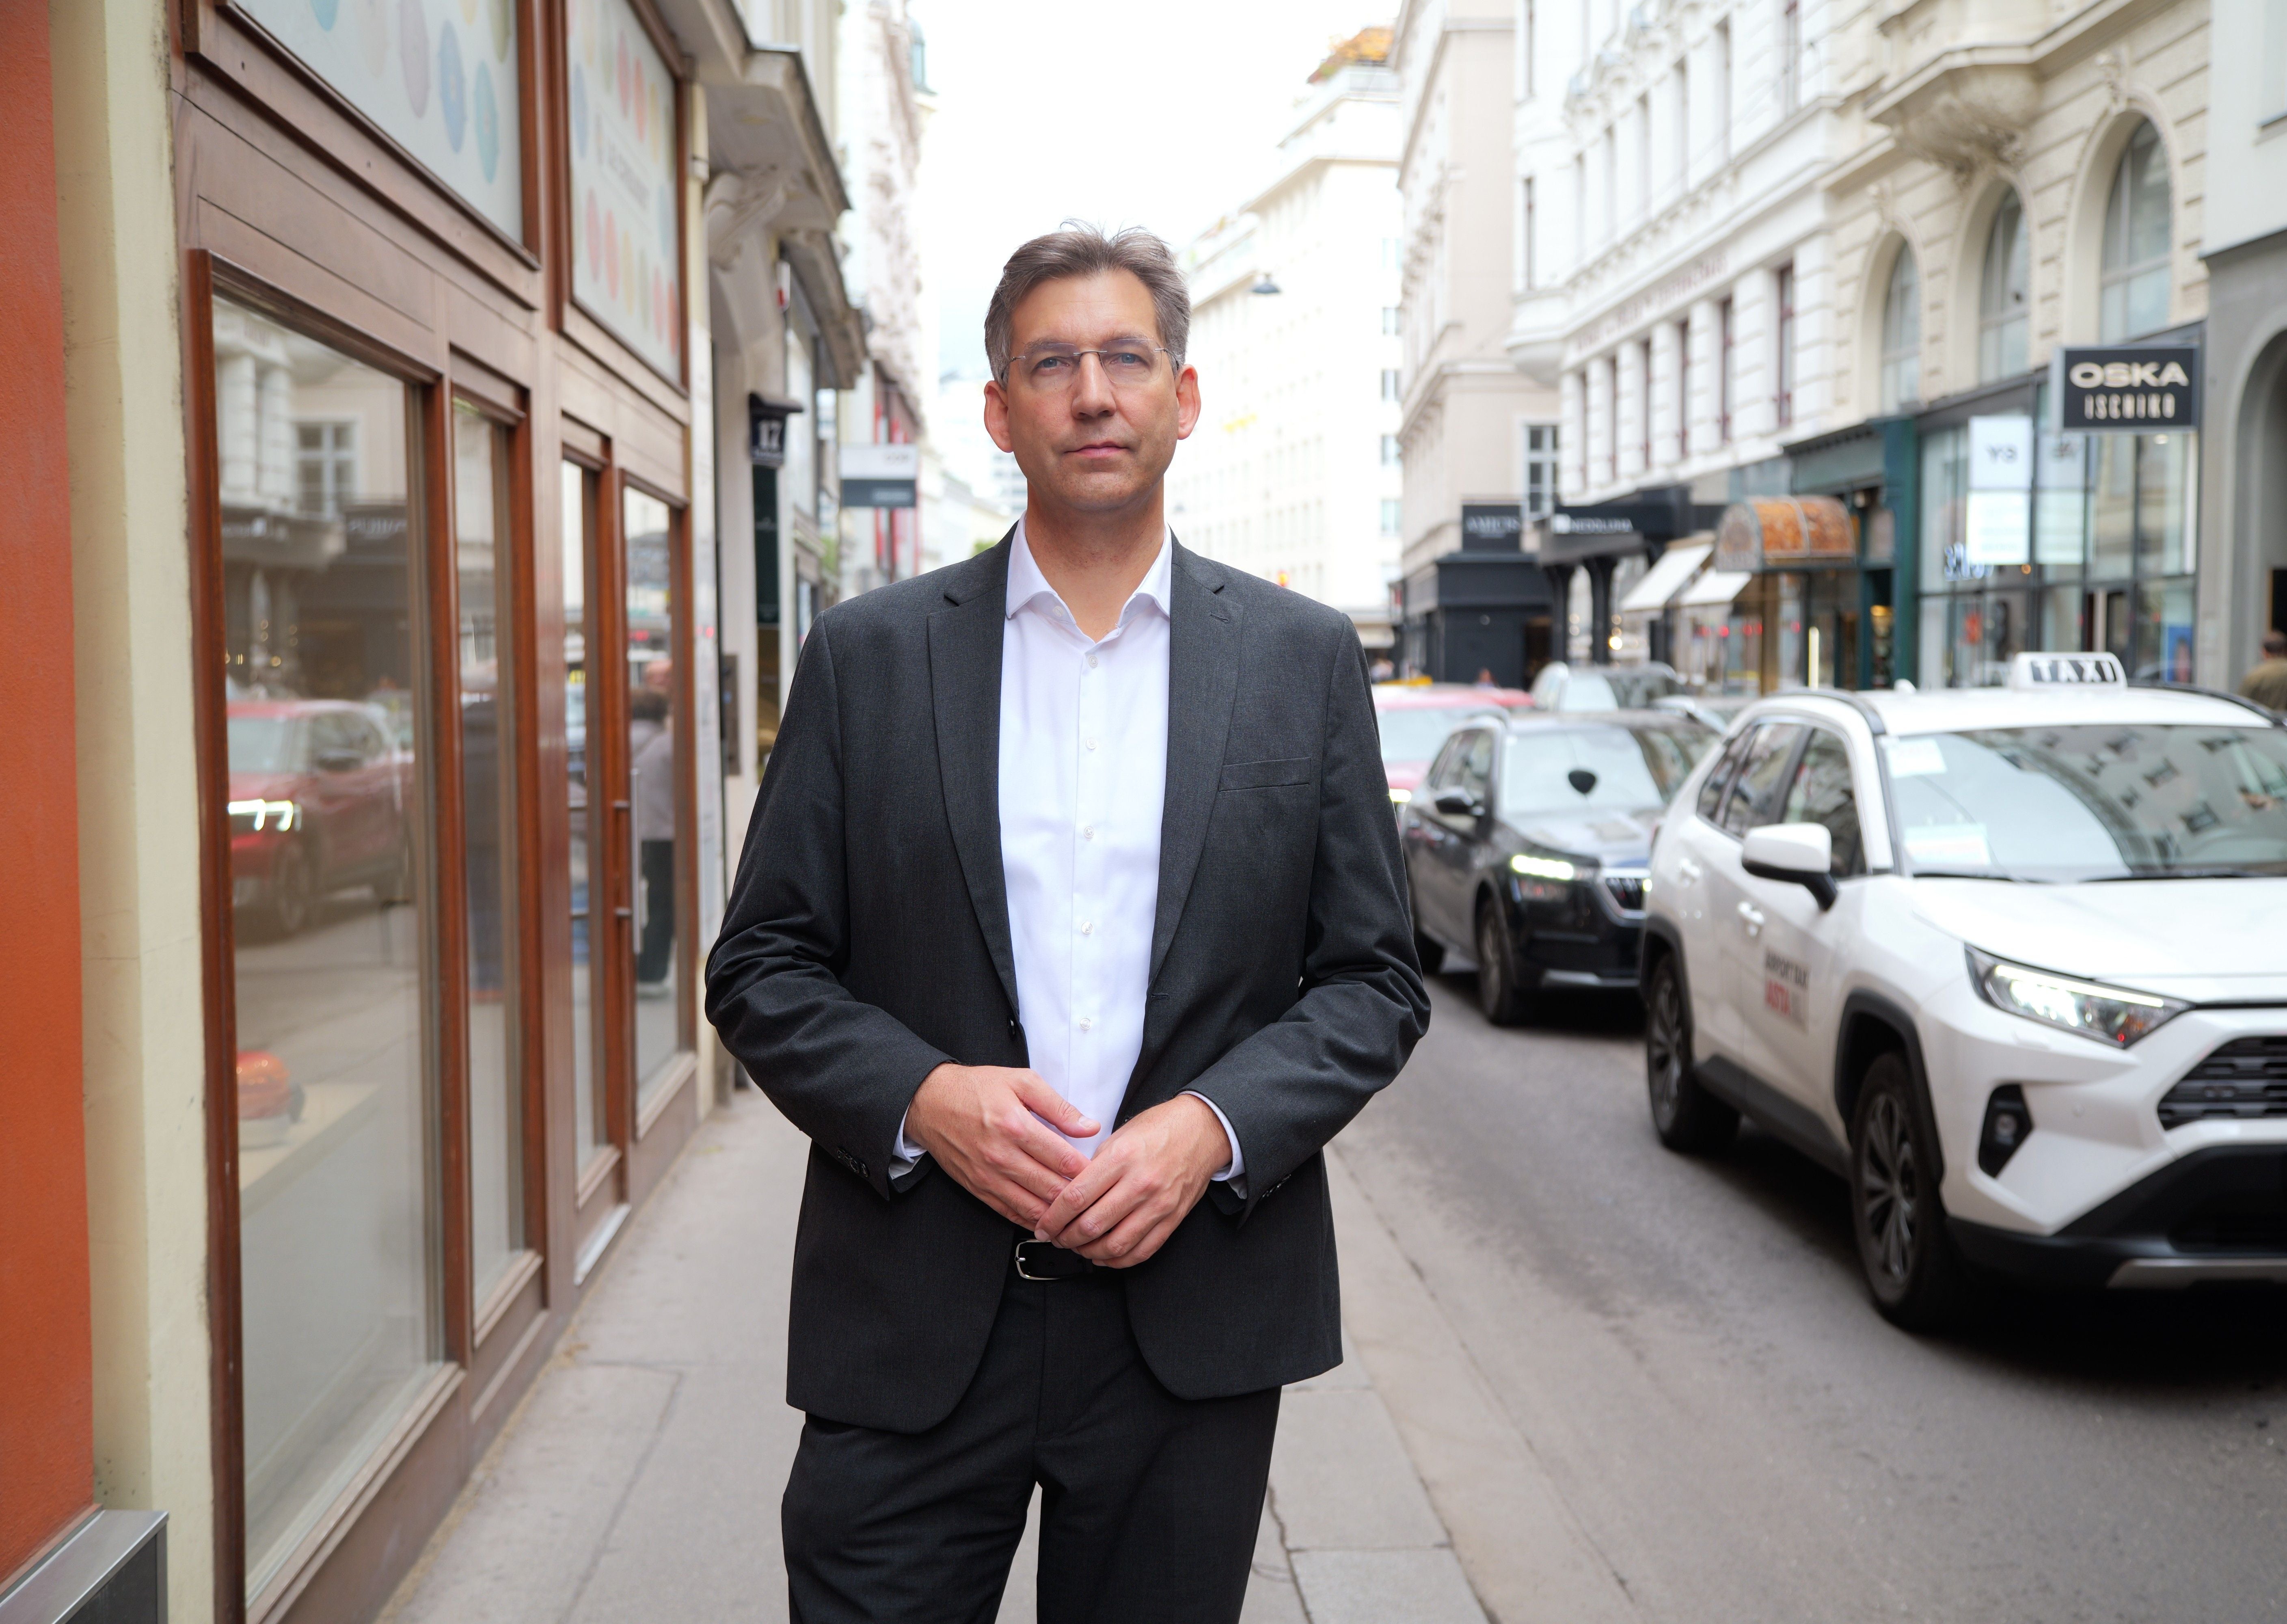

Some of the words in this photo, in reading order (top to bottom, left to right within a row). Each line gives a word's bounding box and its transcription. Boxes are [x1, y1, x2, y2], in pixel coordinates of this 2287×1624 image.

[2069, 361, 2189, 388] OSKA
[758, 420, 782, 449] 17
[2031, 660, 2115, 682] TAXI
